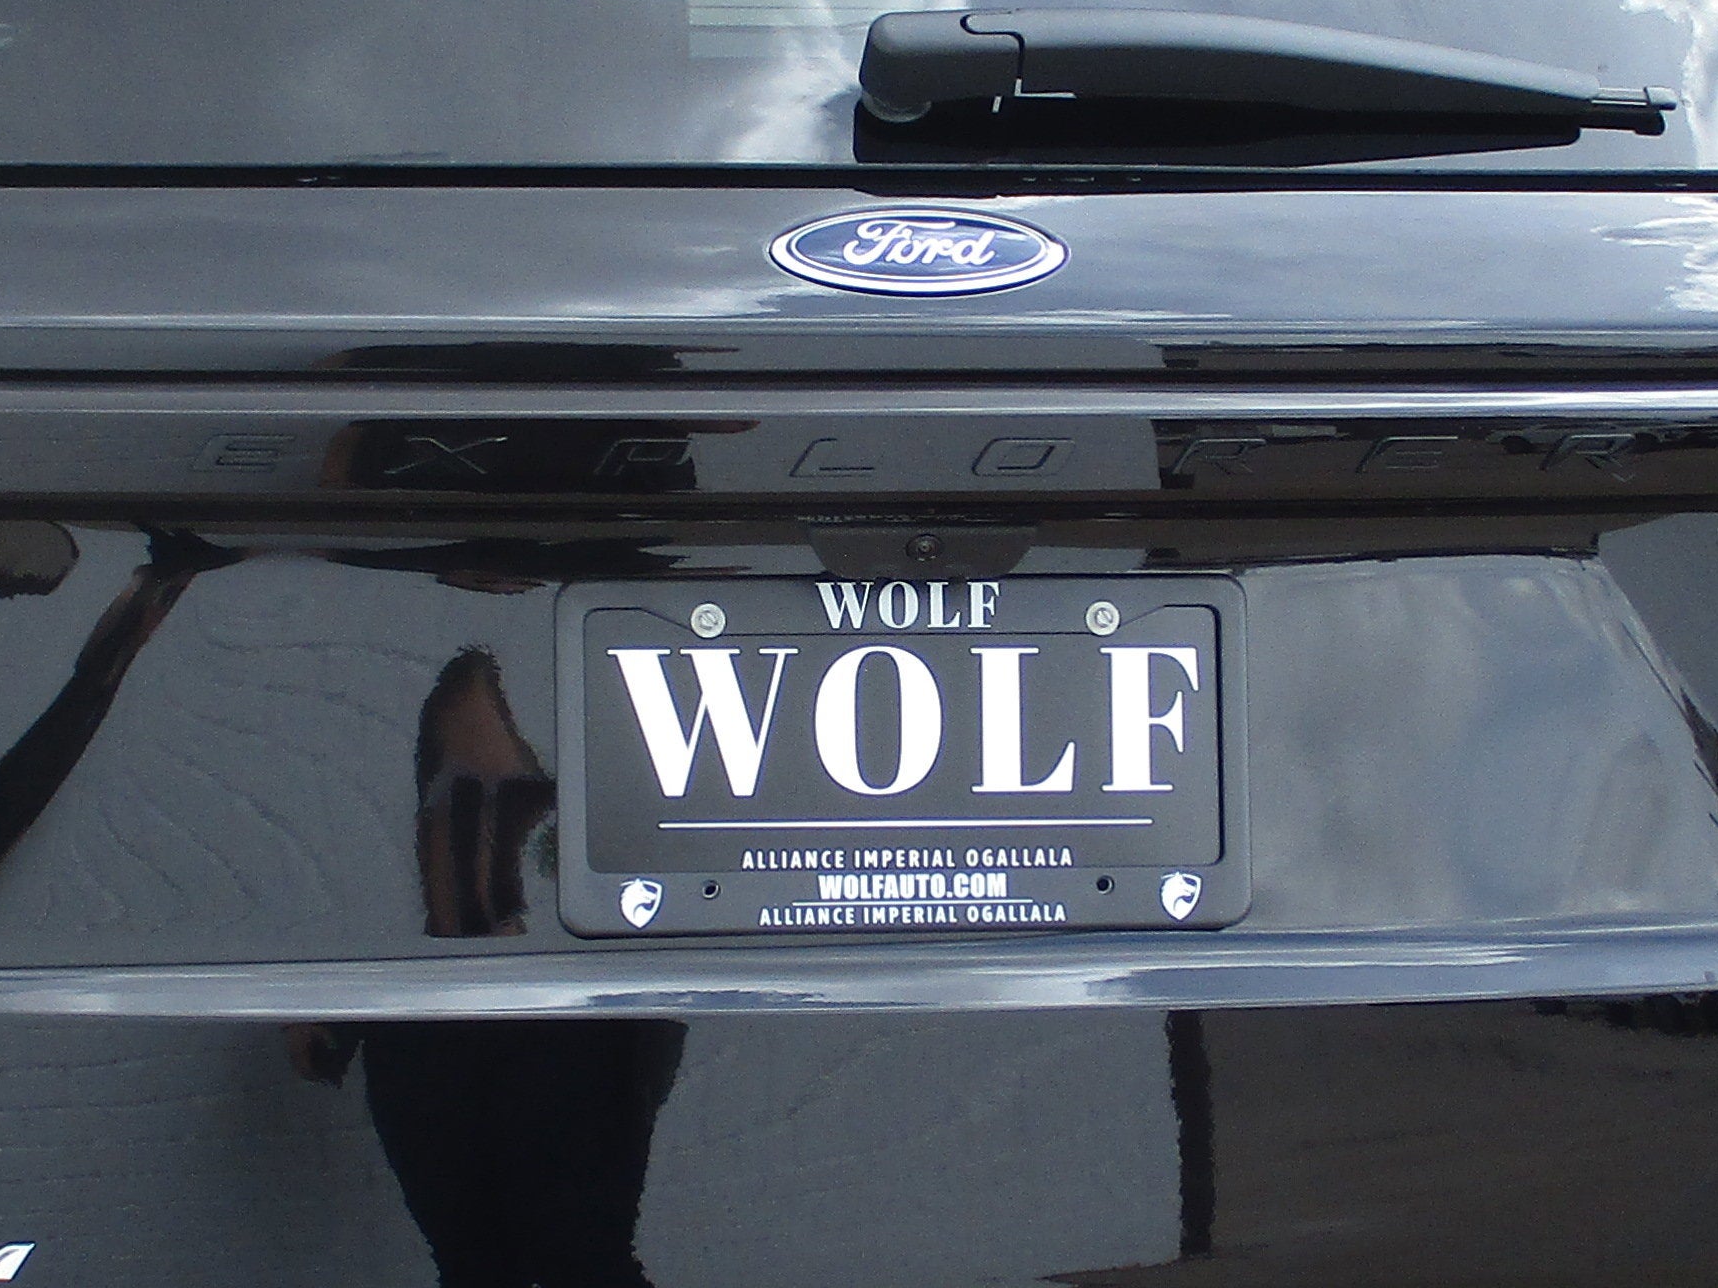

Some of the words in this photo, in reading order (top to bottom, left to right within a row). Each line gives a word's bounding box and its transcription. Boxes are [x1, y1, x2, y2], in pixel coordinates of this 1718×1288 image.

[843, 221, 996, 265] Ford
[193, 431, 1636, 480] EXPLORER
[815, 581, 1001, 631] WOLF
[607, 645, 1202, 798] WOLF
[742, 849, 845, 870] ALLIANCE
[854, 848, 956, 869] IMPERIAL
[965, 847, 1074, 868] OGALLALA
[817, 872, 1008, 900] WOLFAUTO.COM
[759, 907, 855, 927] ALLIANCE
[863, 905, 959, 925] IMPERIAL
[966, 903, 1067, 924] OGALLALA
